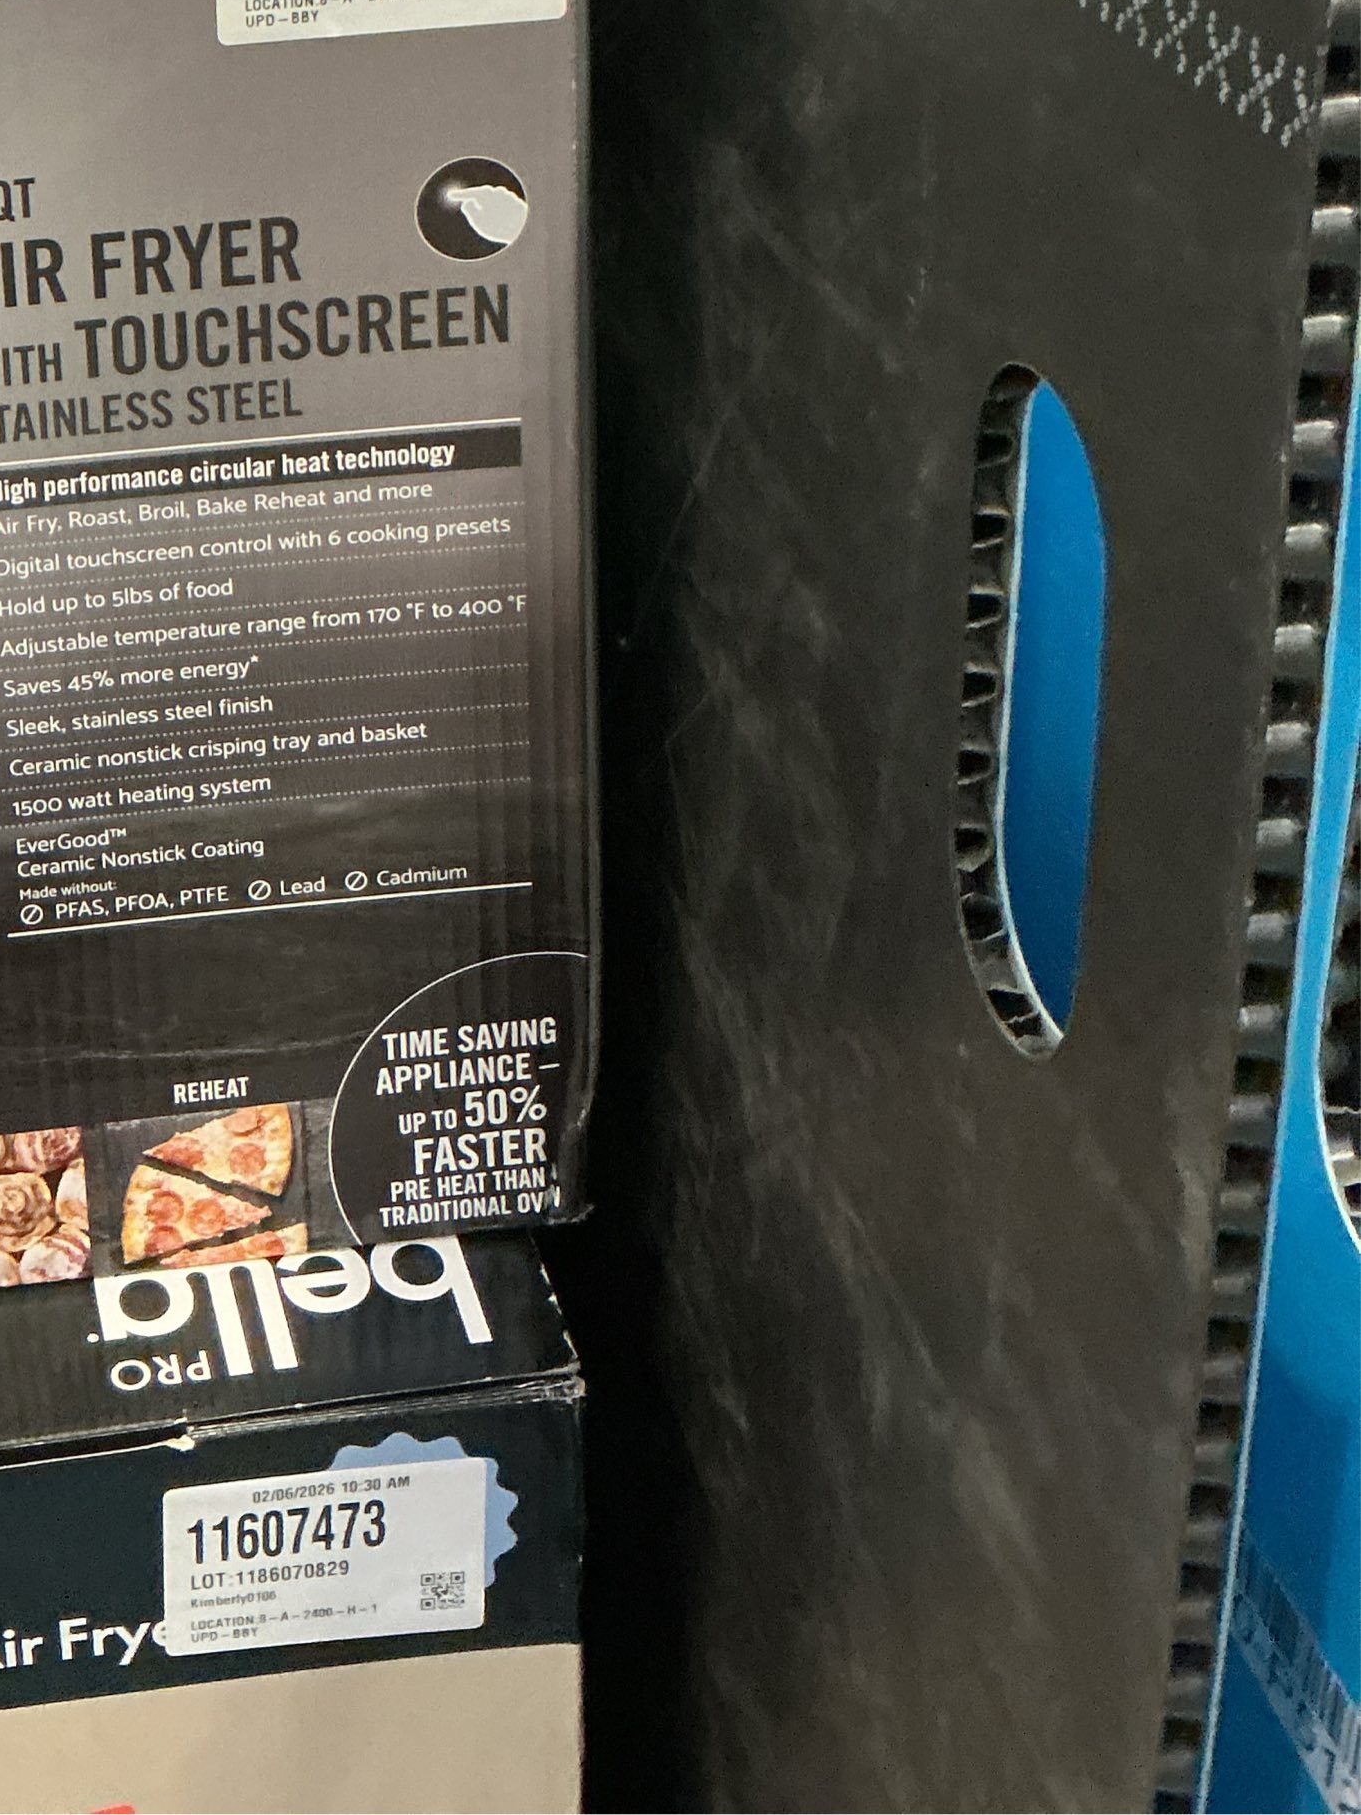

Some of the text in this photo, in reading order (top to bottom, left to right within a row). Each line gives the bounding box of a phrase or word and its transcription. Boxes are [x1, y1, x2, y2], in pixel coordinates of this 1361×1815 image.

[90, 216, 302, 300] FRYER
[74, 284, 510, 379] TOUCHSCREEN
[186, 377, 303, 425] STEEL
[43, 465, 183, 499] performance
[190, 456, 274, 484] circular
[281, 451, 330, 475] heat
[336, 443, 455, 472] technology
[27, 513, 63, 535] Fry,
[68, 507, 133, 528] Roast,
[139, 501, 191, 522] Broil,
[197, 496, 247, 517] Bake
[254, 489, 326, 511] Reheat
[333, 484, 372, 504] and
[378, 482, 433, 500] more
[67, 542, 193, 570] touchscreen
[200, 535, 272, 557] control
[278, 530, 322, 550] with
[328, 529, 341, 545] 6
[347, 522, 429, 548] cooking
[435, 516, 511, 541] presets
[52, 596, 79, 616] up
[85, 591, 106, 609] to
[112, 585, 153, 608] 5lbs
[159, 582, 180, 602] of
[186, 578, 233, 599] food
[0, 630, 108, 659] Adjustable
[114, 619, 240, 650] temperature
[247, 615, 306, 639] range
[311, 607, 361, 628] from
[366, 606, 401, 624] 170
[431, 600, 453, 618] to
[459, 598, 502, 616] 400
[2, 675, 62, 698] Saves
[68, 669, 115, 692] 45%
[119, 665, 174, 685] more
[6, 694, 274, 738] Sleek, stainless steel finish
[9, 723, 428, 778] Ceramic nonstick crisping tray and basket
[12, 774, 272, 817] 1500 watt heating system
[17, 837, 265, 879] Ceramic Nonstick Coating
[20, 879, 117, 901] Made without:
[55, 864, 468, 922] PFAS, PFOA, PTFE Lead Cadmium
[382, 1017, 557, 1061] TIME SAVING
[174, 1076, 249, 1104] REHEAT
[376, 1053, 531, 1096] APPLIANCE
[399, 1085, 547, 1135] UP TO 50%
[414, 1128, 547, 1175] FASTER
[390, 1166, 546, 1203] PRE HEAT THAN
[379, 1192, 513, 1227] TRADITIONAL
[93, 1236, 493, 1377] bella
[110, 1350, 214, 1392] PRO
[252, 1475, 410, 1504] 02/06/2026 10:30 AM
[186, 1499, 387, 1565] 11607473
[191, 1560, 350, 1591] LOT:1186070829
[59, 1617, 166, 1667] Frye
